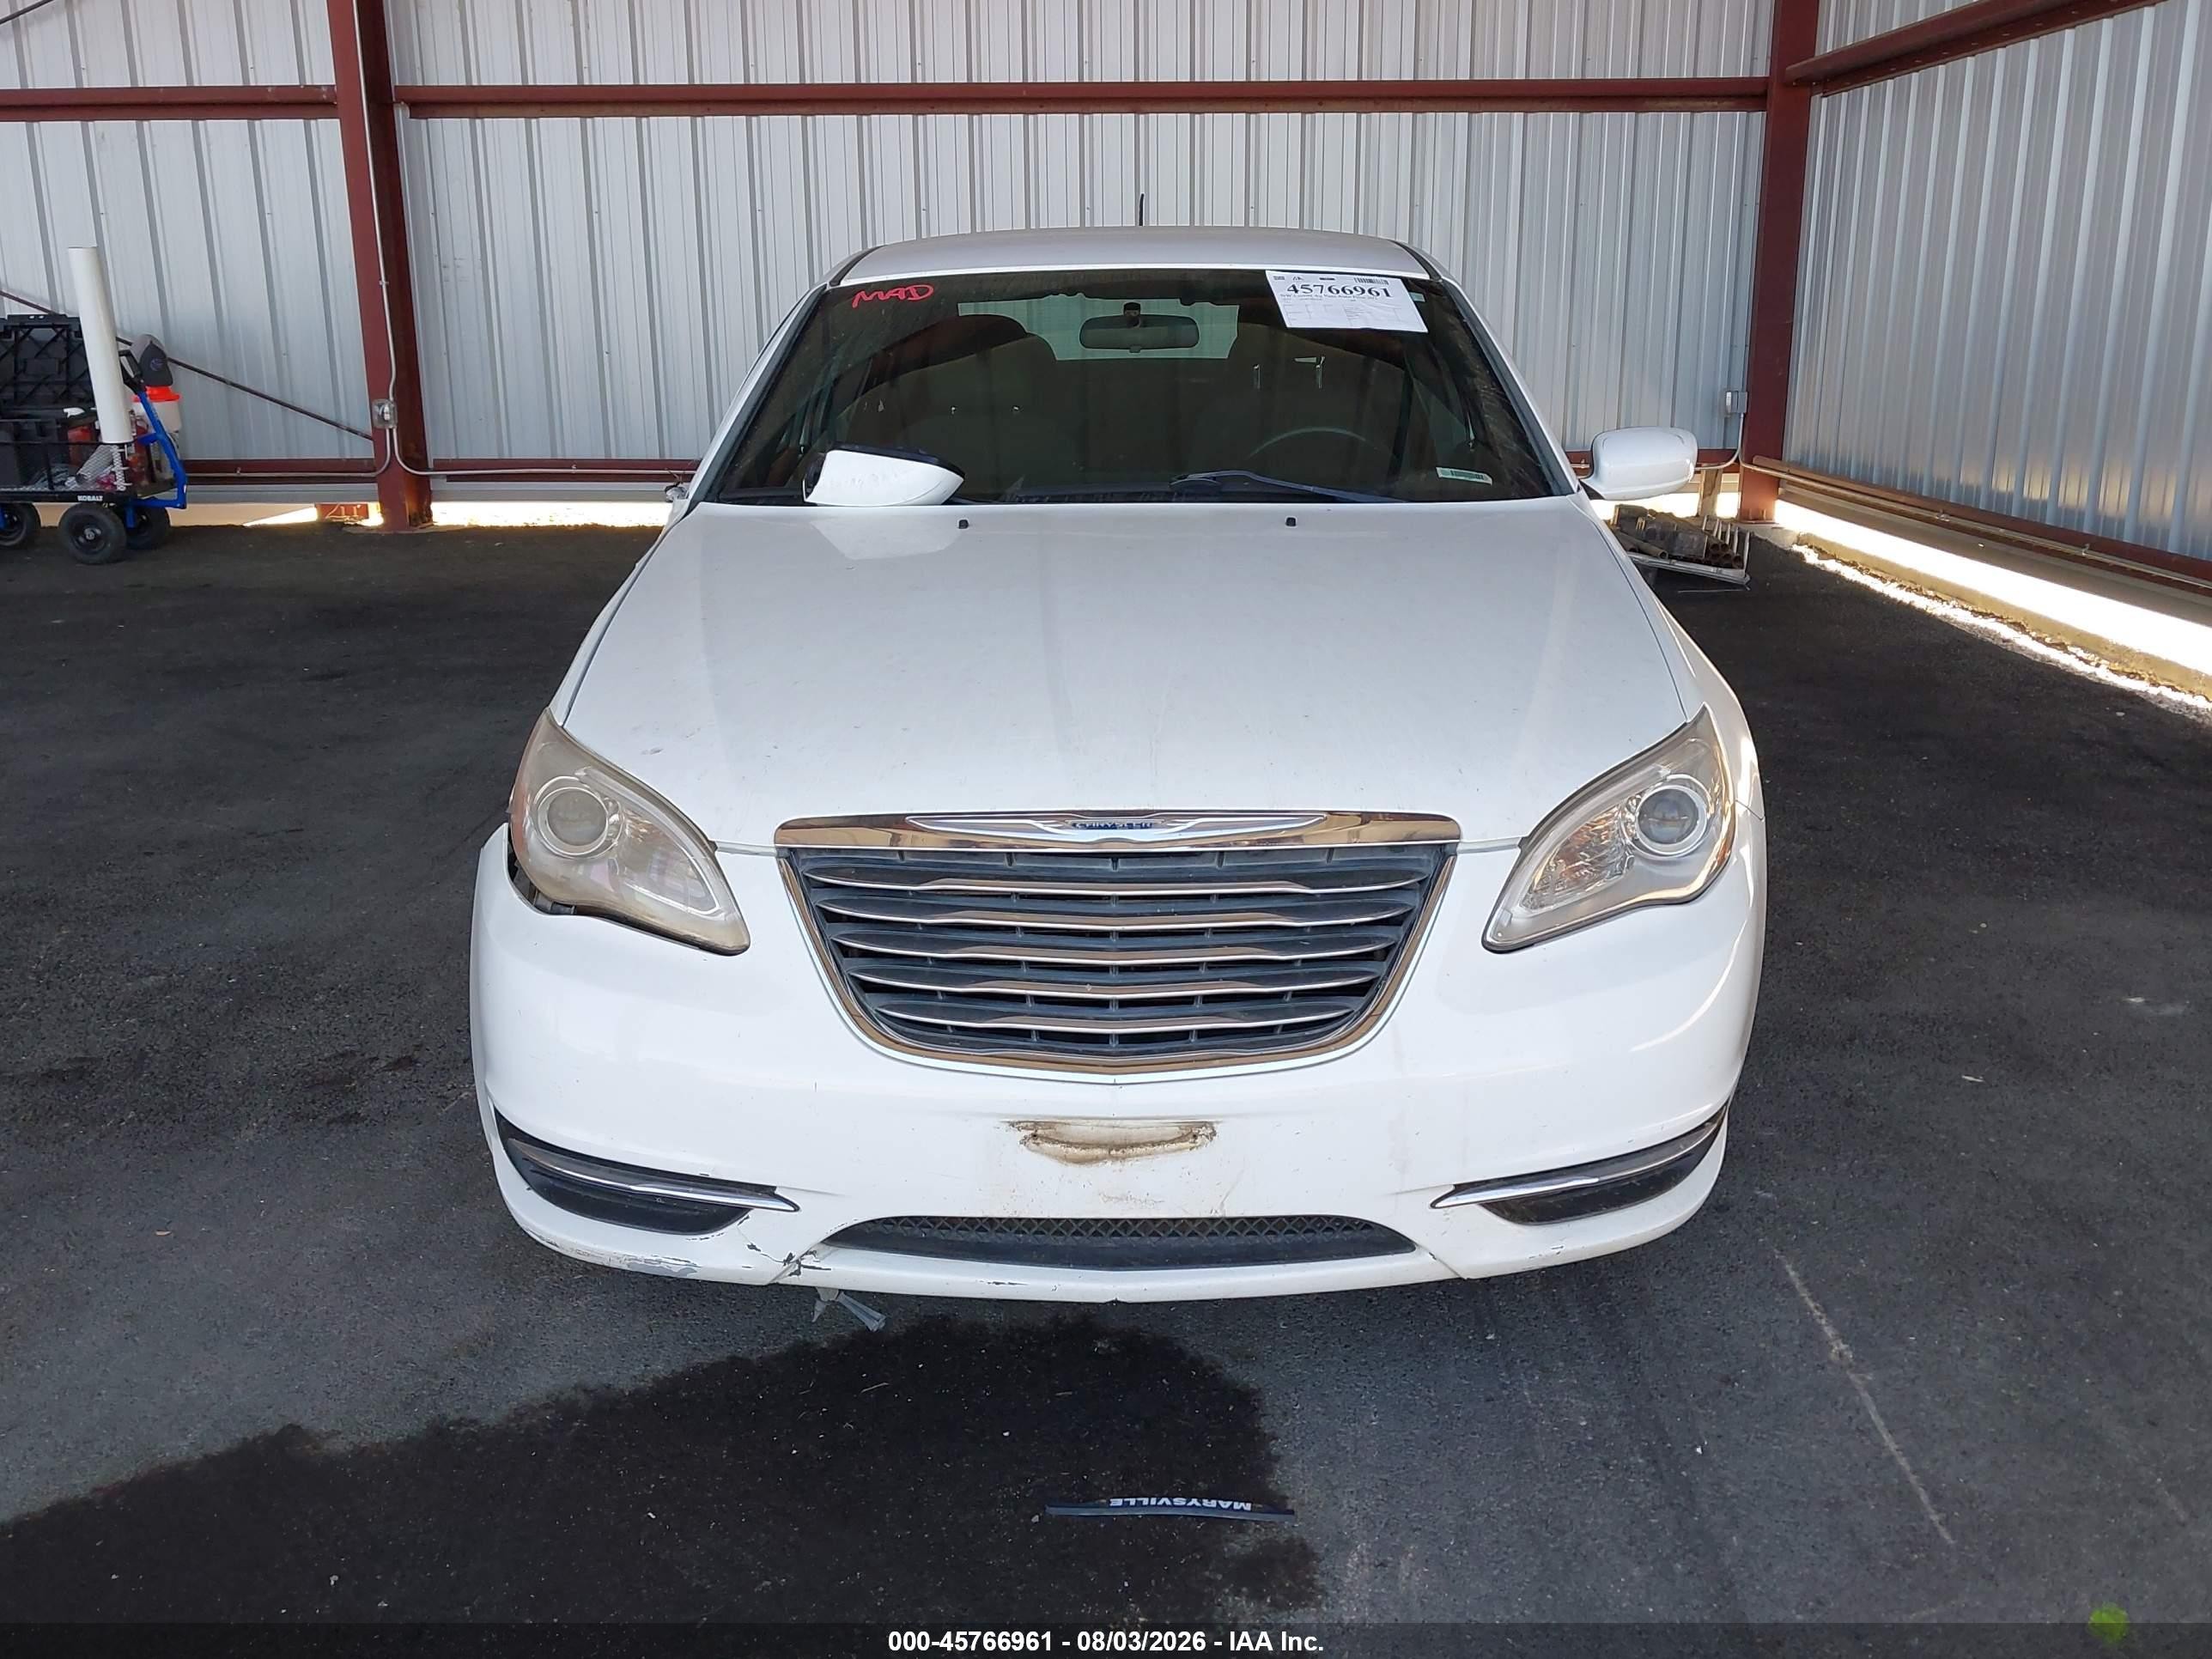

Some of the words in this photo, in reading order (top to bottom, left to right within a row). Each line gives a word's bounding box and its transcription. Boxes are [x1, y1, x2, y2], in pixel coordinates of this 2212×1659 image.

[852, 284, 934, 309] MAD
[1286, 283, 1394, 298] 45766961
[1109, 1497, 1252, 1511] MARYSVILLE
